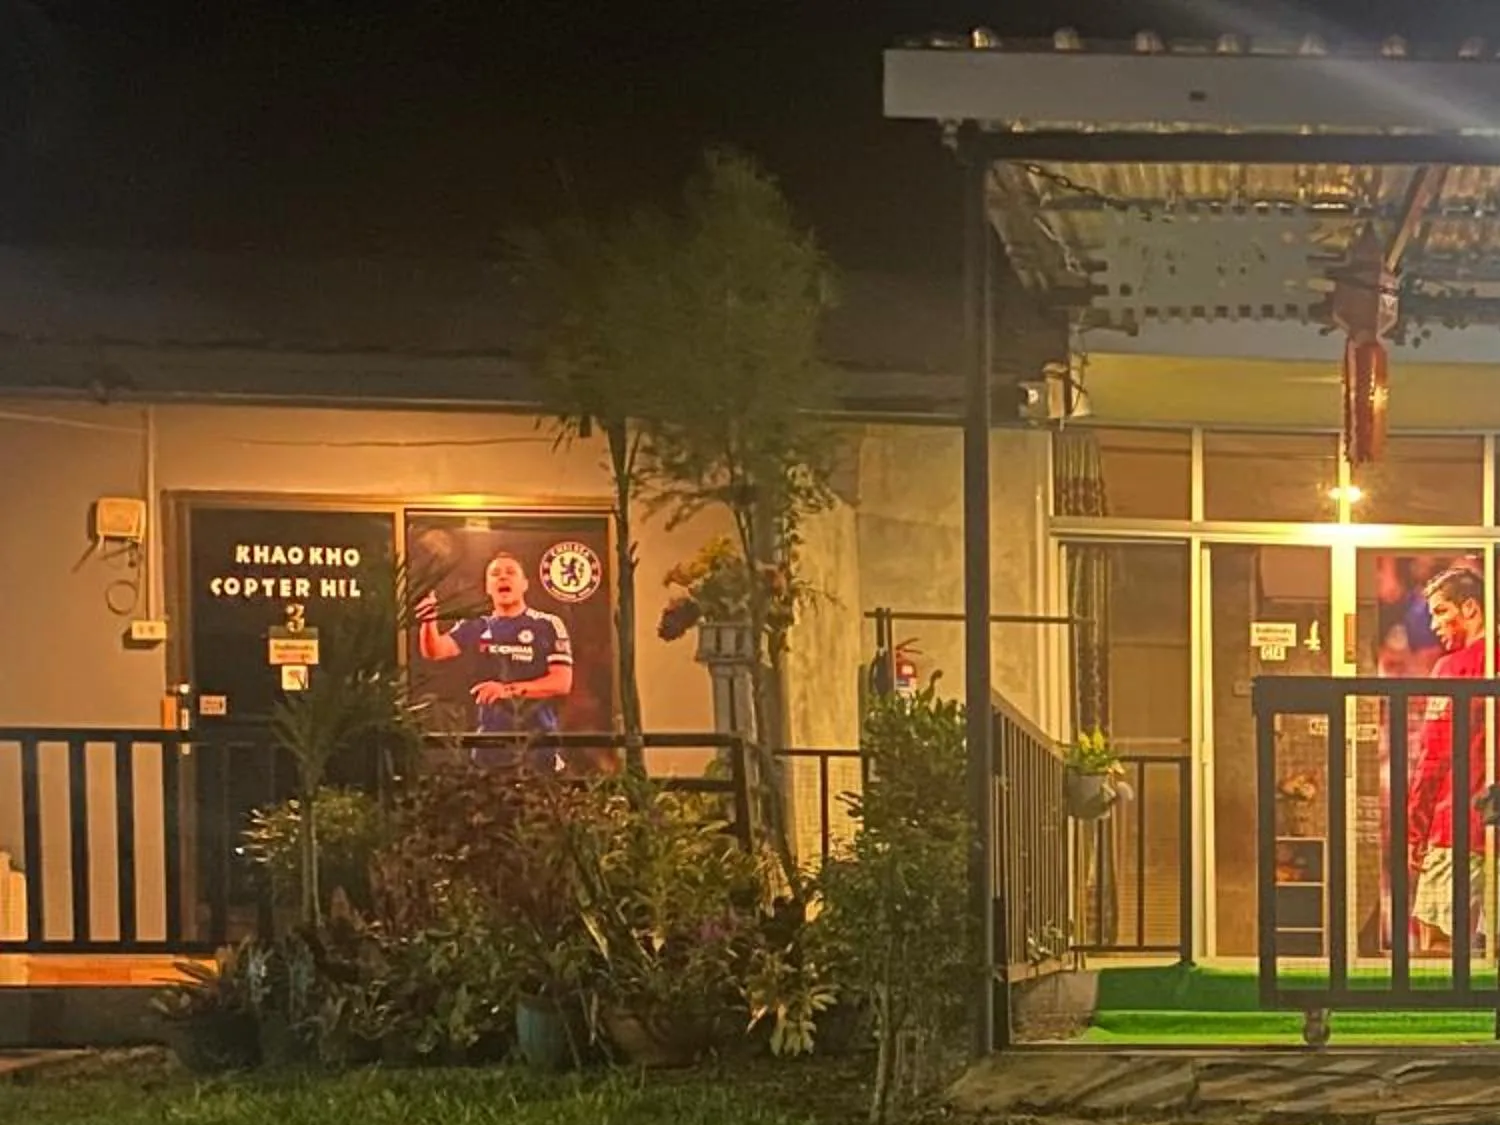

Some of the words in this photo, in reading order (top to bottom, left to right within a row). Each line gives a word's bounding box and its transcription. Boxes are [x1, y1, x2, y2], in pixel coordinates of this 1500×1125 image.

[236, 545, 303, 564] KHAO
[309, 547, 360, 567] KHO
[210, 577, 310, 597] COPTER
[320, 578, 361, 597] HIL
[284, 603, 304, 632] 3
